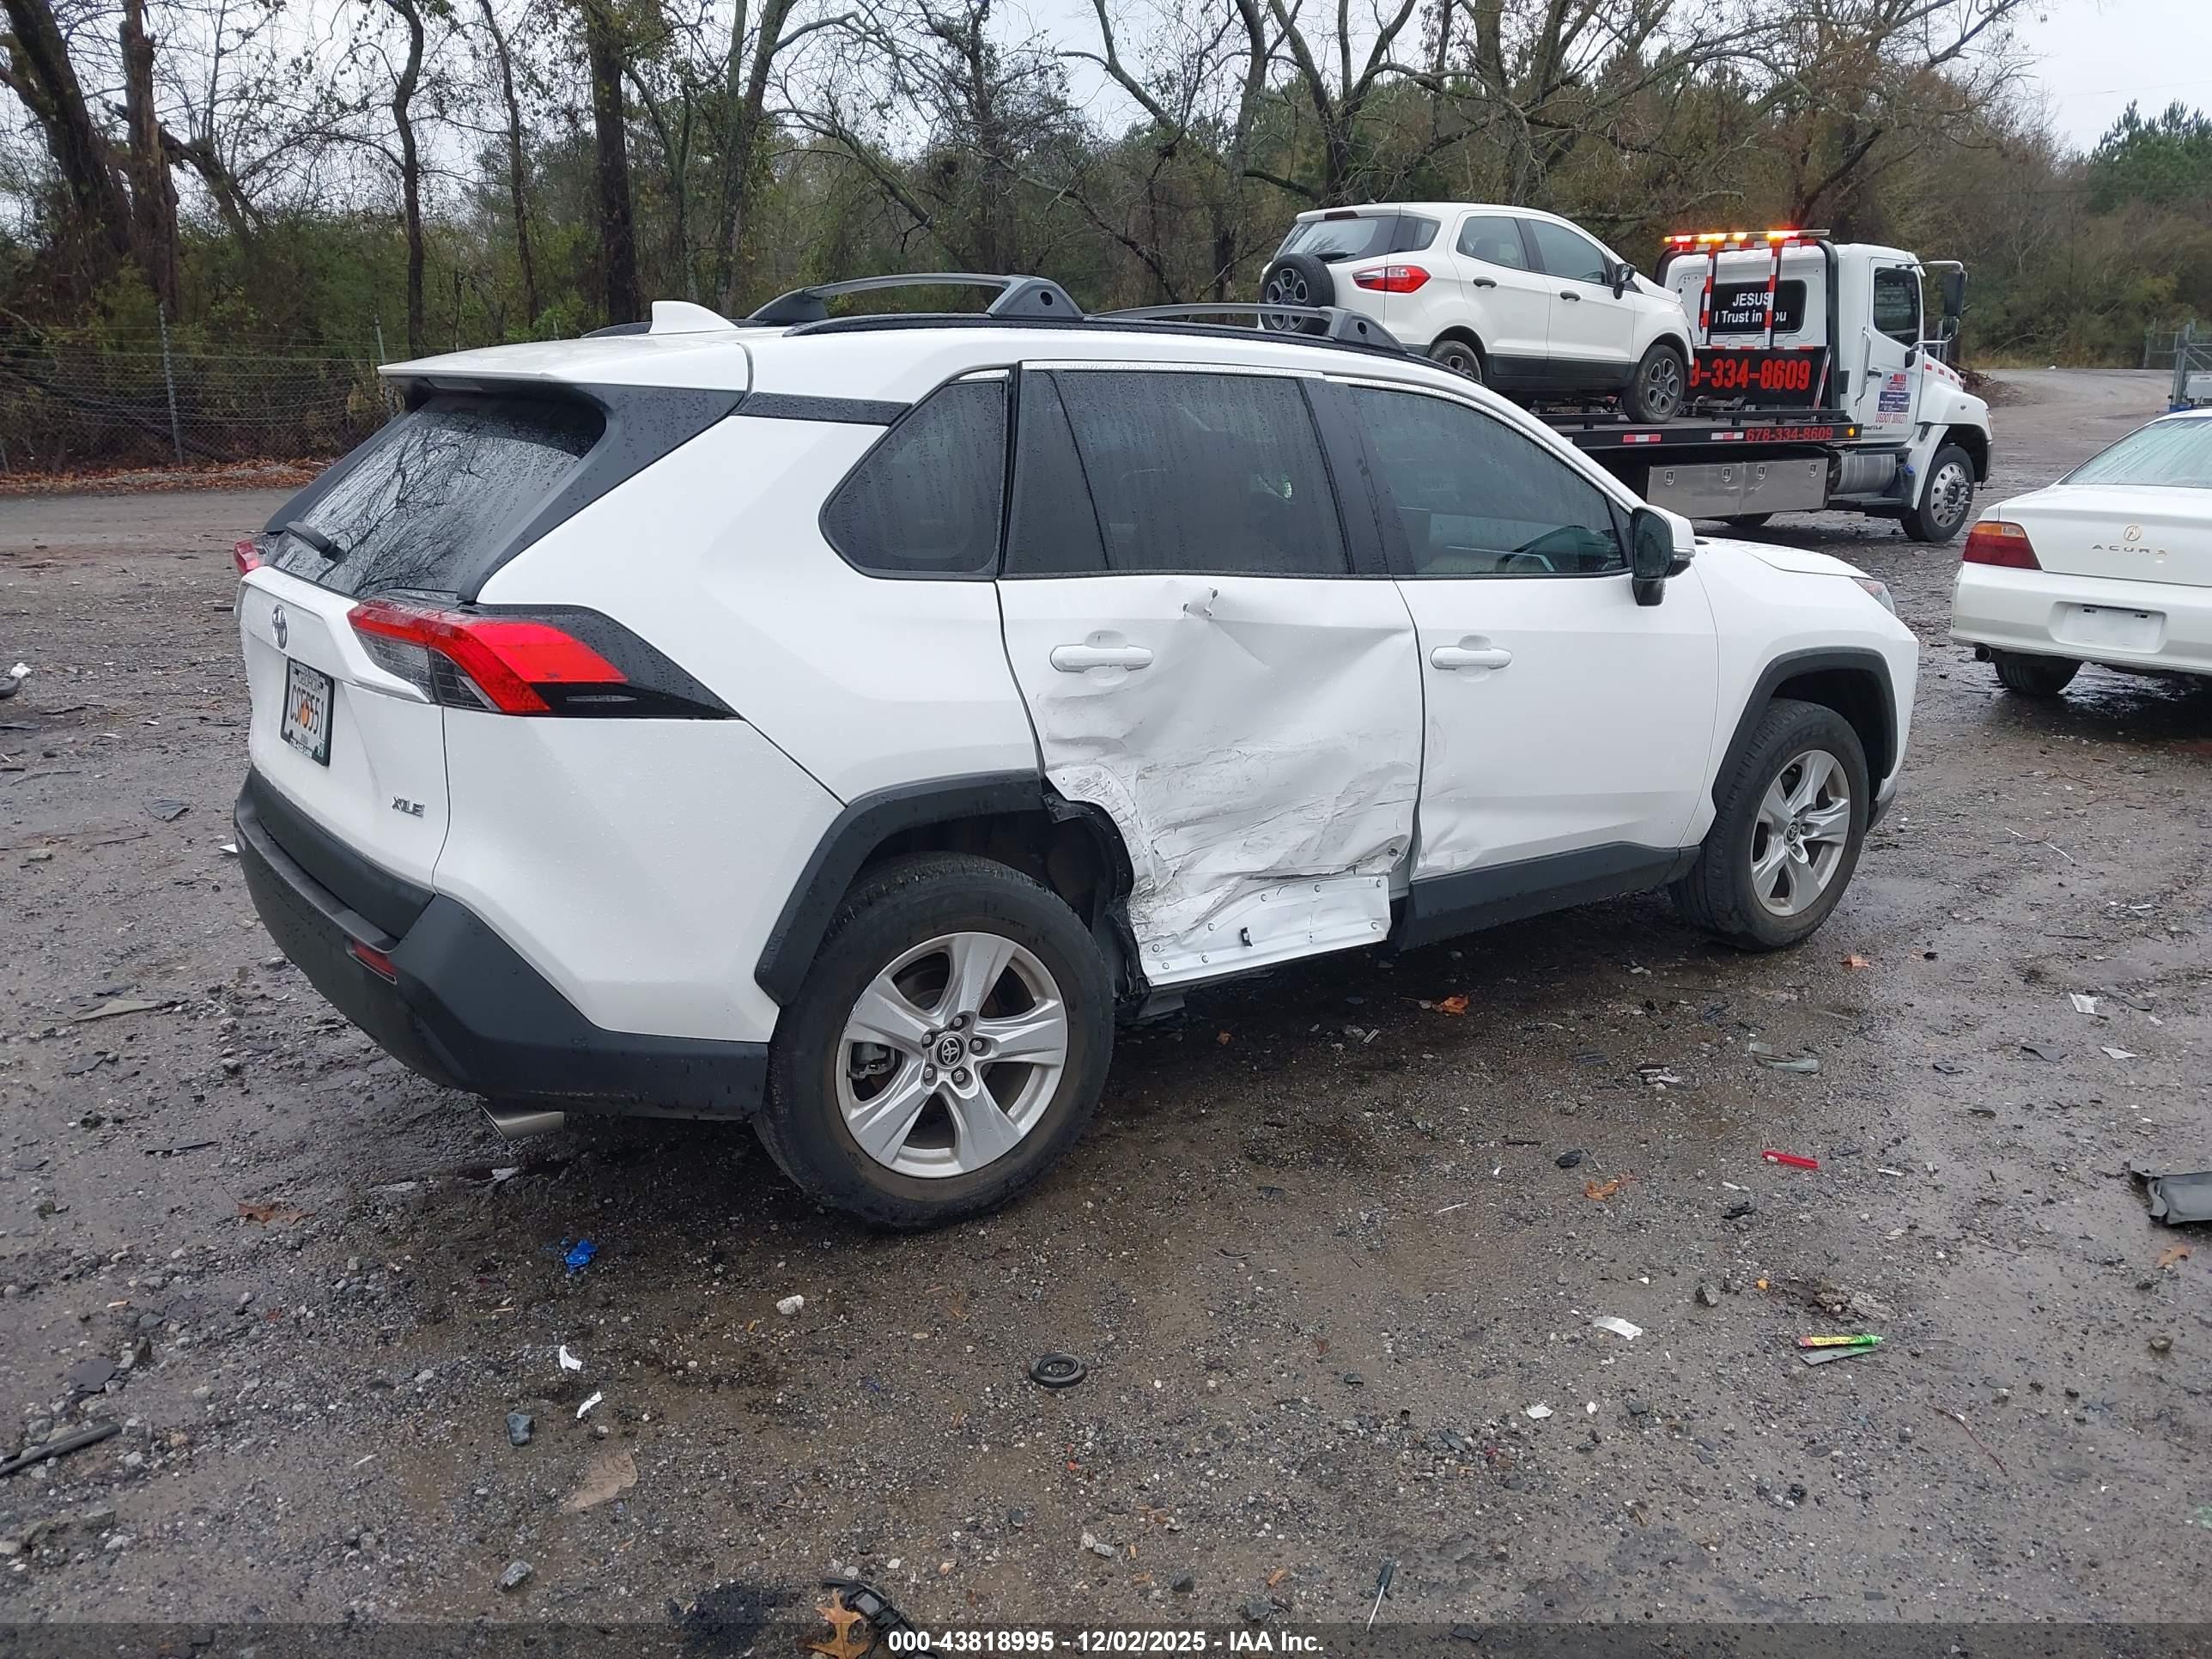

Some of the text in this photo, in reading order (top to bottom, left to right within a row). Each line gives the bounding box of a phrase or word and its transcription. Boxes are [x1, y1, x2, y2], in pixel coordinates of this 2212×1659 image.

[1733, 293, 1770, 307] JESUS
[1715, 310, 1718, 324] I
[1722, 310, 1750, 323] Trust
[1752, 310, 1763, 323] in
[1746, 426, 1834, 441] 678-334-8609
[2092, 544, 2168, 556] ACURA
[392, 796, 425, 817] XLE
